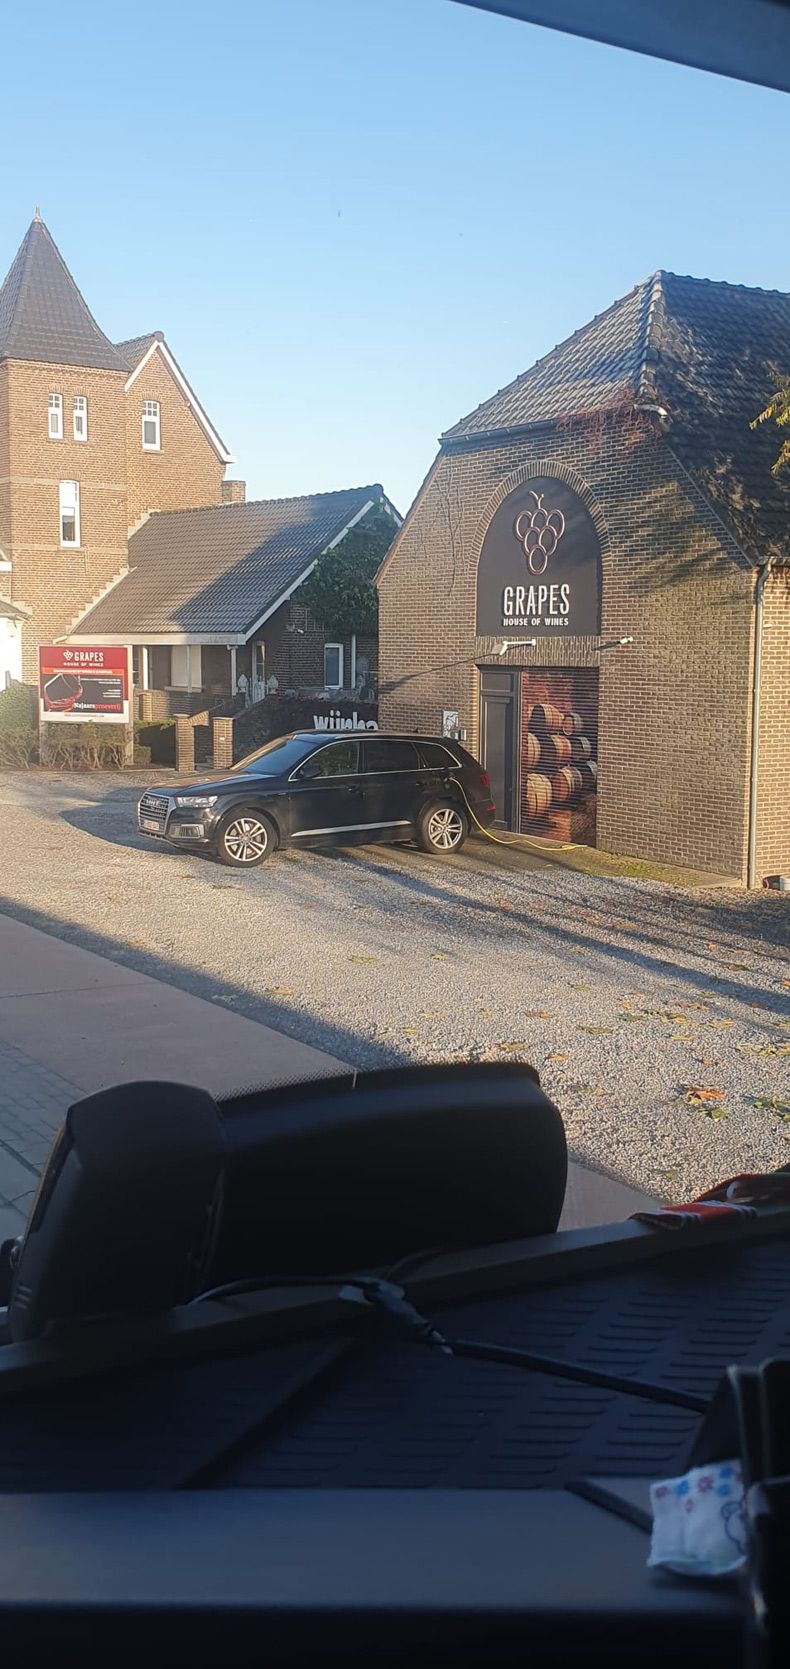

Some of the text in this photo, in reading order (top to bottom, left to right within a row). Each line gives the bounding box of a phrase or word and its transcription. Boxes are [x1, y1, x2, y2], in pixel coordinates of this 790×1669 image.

[503, 583, 570, 616] GRAPES
[503, 617, 569, 626] HOUSE OF WINES
[74, 651, 104, 662] GRAPES
